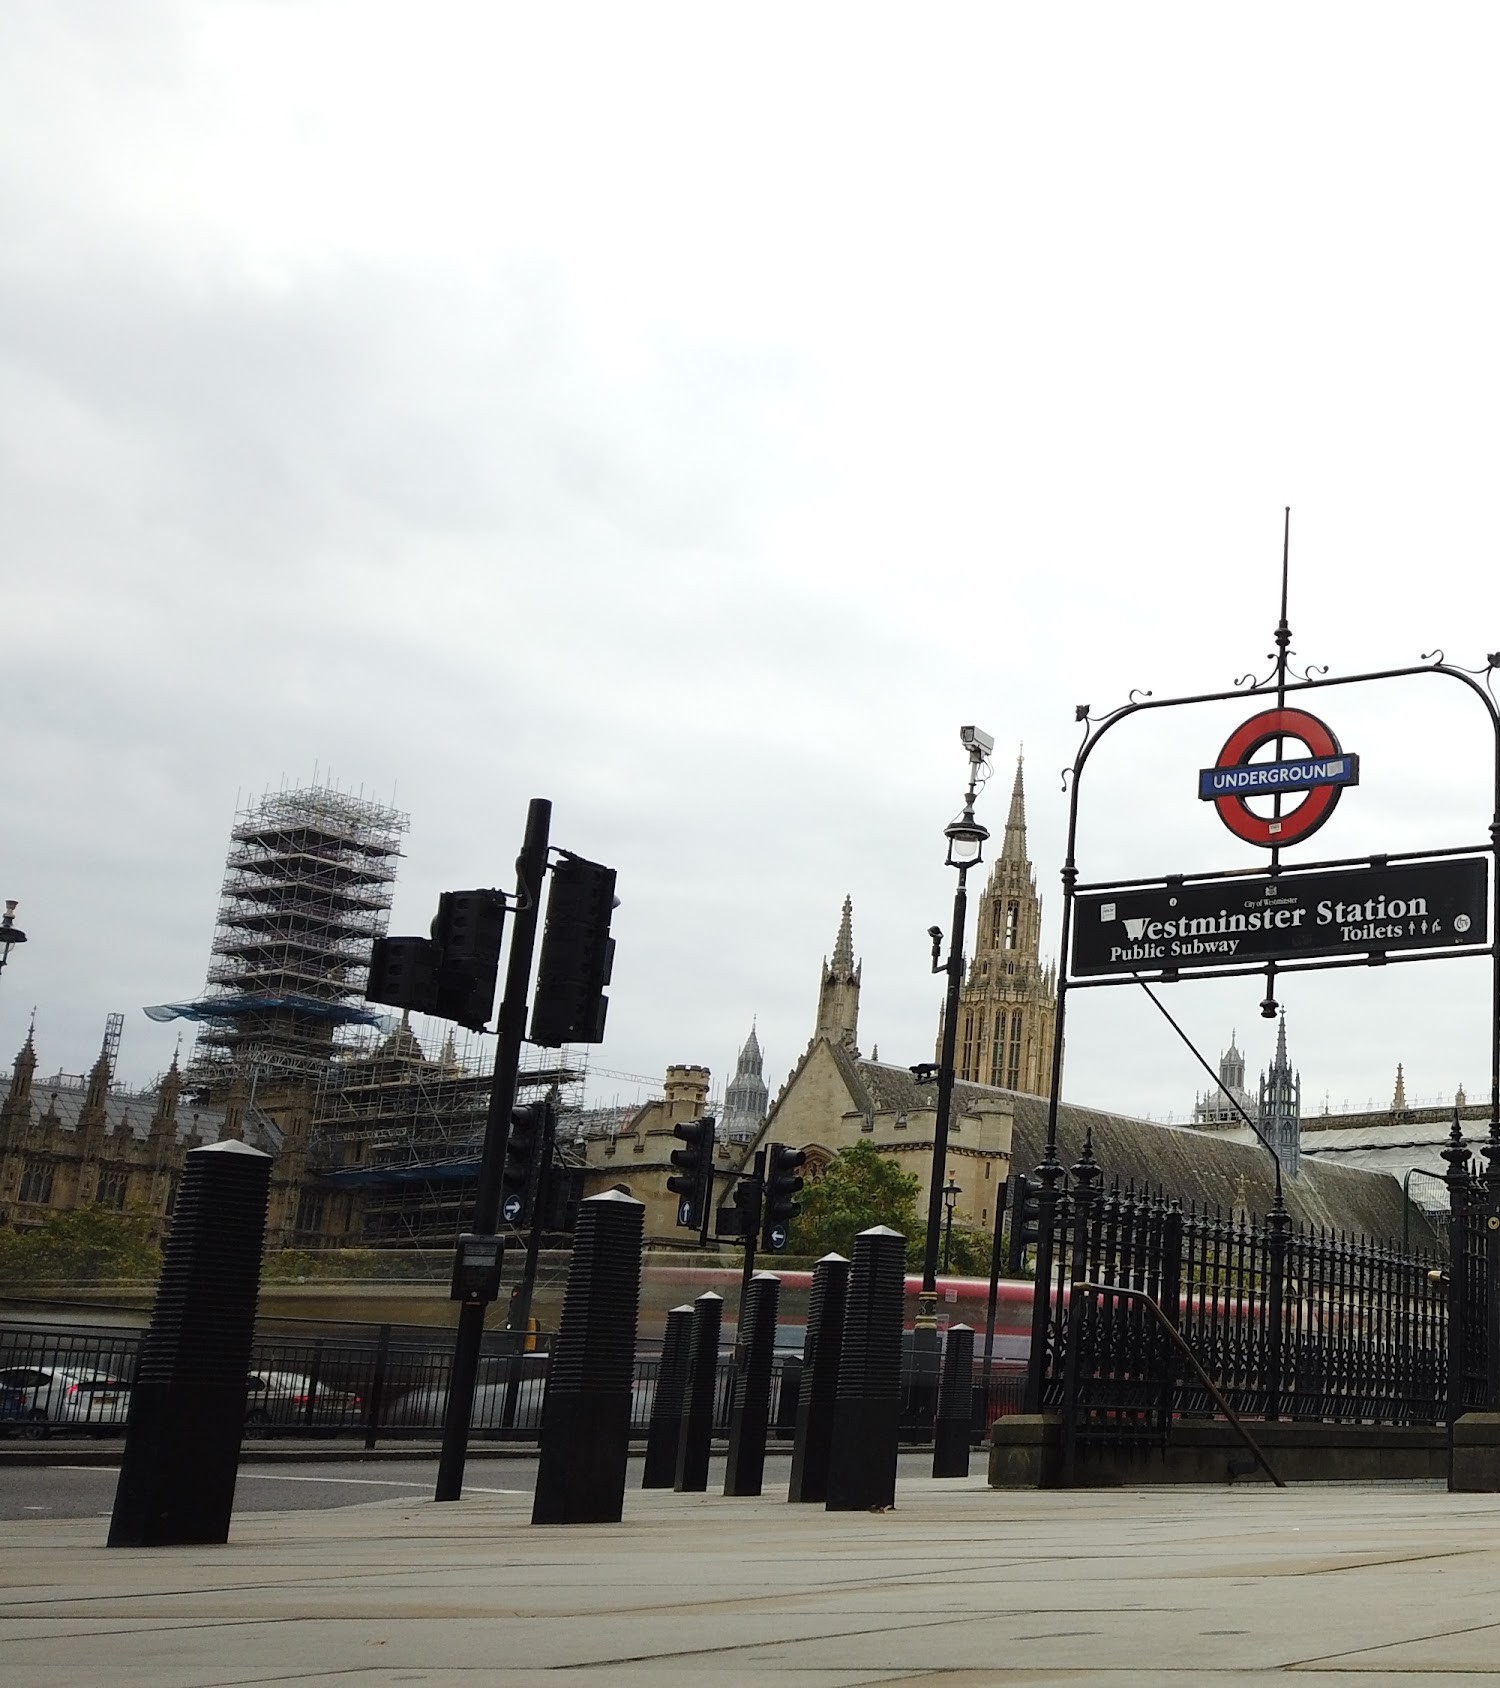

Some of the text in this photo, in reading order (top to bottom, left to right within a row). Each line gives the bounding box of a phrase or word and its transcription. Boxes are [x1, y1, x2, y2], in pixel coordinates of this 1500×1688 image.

[1213, 762, 1339, 789] UNDERGROUN
[1316, 894, 1429, 925] Station
[1340, 922, 1403, 942] Toilets
[1110, 938, 1240, 962] Public Subway
